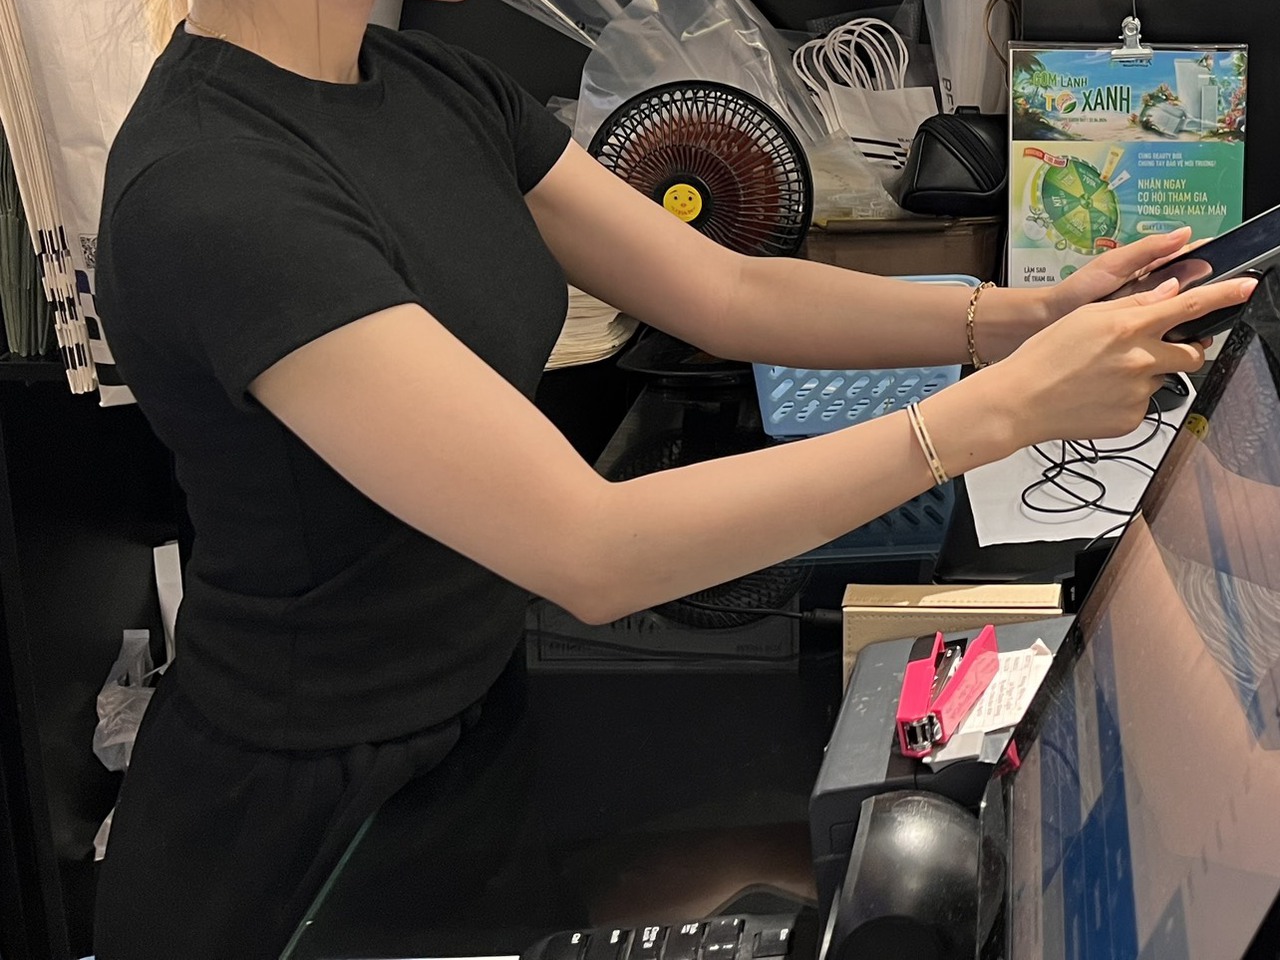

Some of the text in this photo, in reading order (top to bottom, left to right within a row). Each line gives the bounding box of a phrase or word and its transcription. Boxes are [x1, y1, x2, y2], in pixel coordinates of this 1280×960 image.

[1082, 85, 1131, 114] XANH
[1138, 177, 1186, 191] NHẬN NGAY
[1152, 191, 1166, 204] HỘI
[1169, 192, 1191, 202] THAM
[1194, 192, 1208, 202] GIA
[1163, 205, 1186, 215] QUAY
[1188, 205, 1205, 215] MAY
